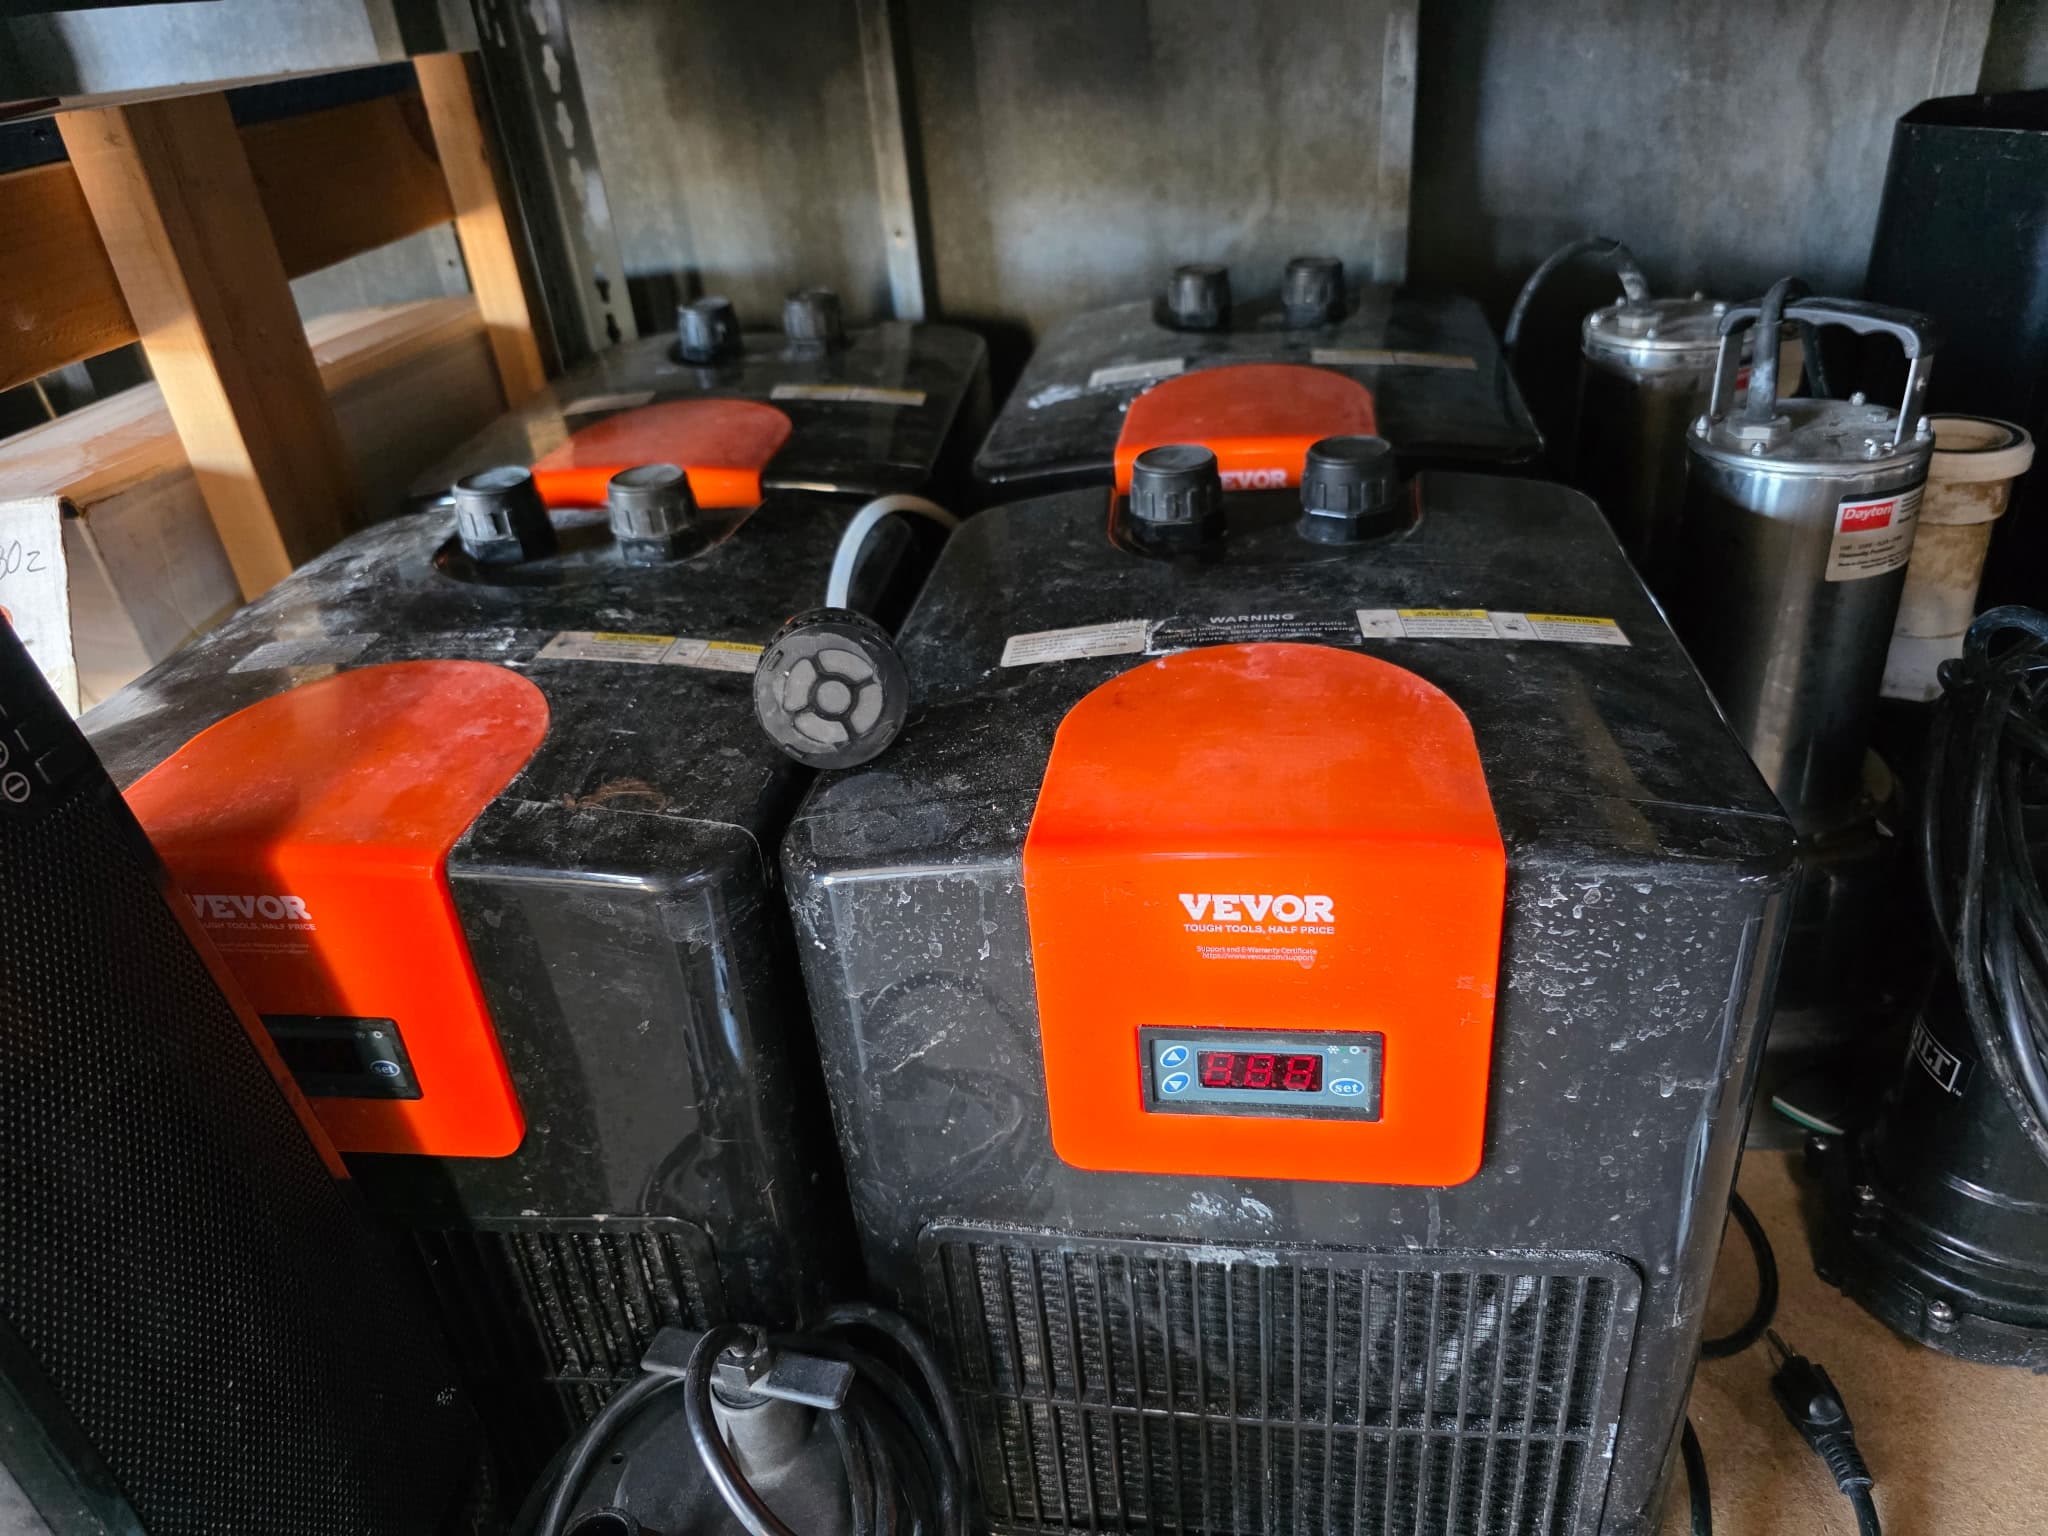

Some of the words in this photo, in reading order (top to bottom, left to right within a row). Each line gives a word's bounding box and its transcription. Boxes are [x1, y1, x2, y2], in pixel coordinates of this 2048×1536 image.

[1218, 469, 1287, 490] EVOR
[1844, 505, 1892, 521] Dayton
[1210, 614, 1295, 624] WARNING
[1178, 893, 1334, 923] VEVOR
[1184, 924, 1222, 933] TOUGH
[1225, 925, 1265, 934] TOOLS,
[1268, 926, 1298, 934] HALF
[1301, 926, 1334, 935] PRICE
[1335, 1082, 1358, 1093] set
